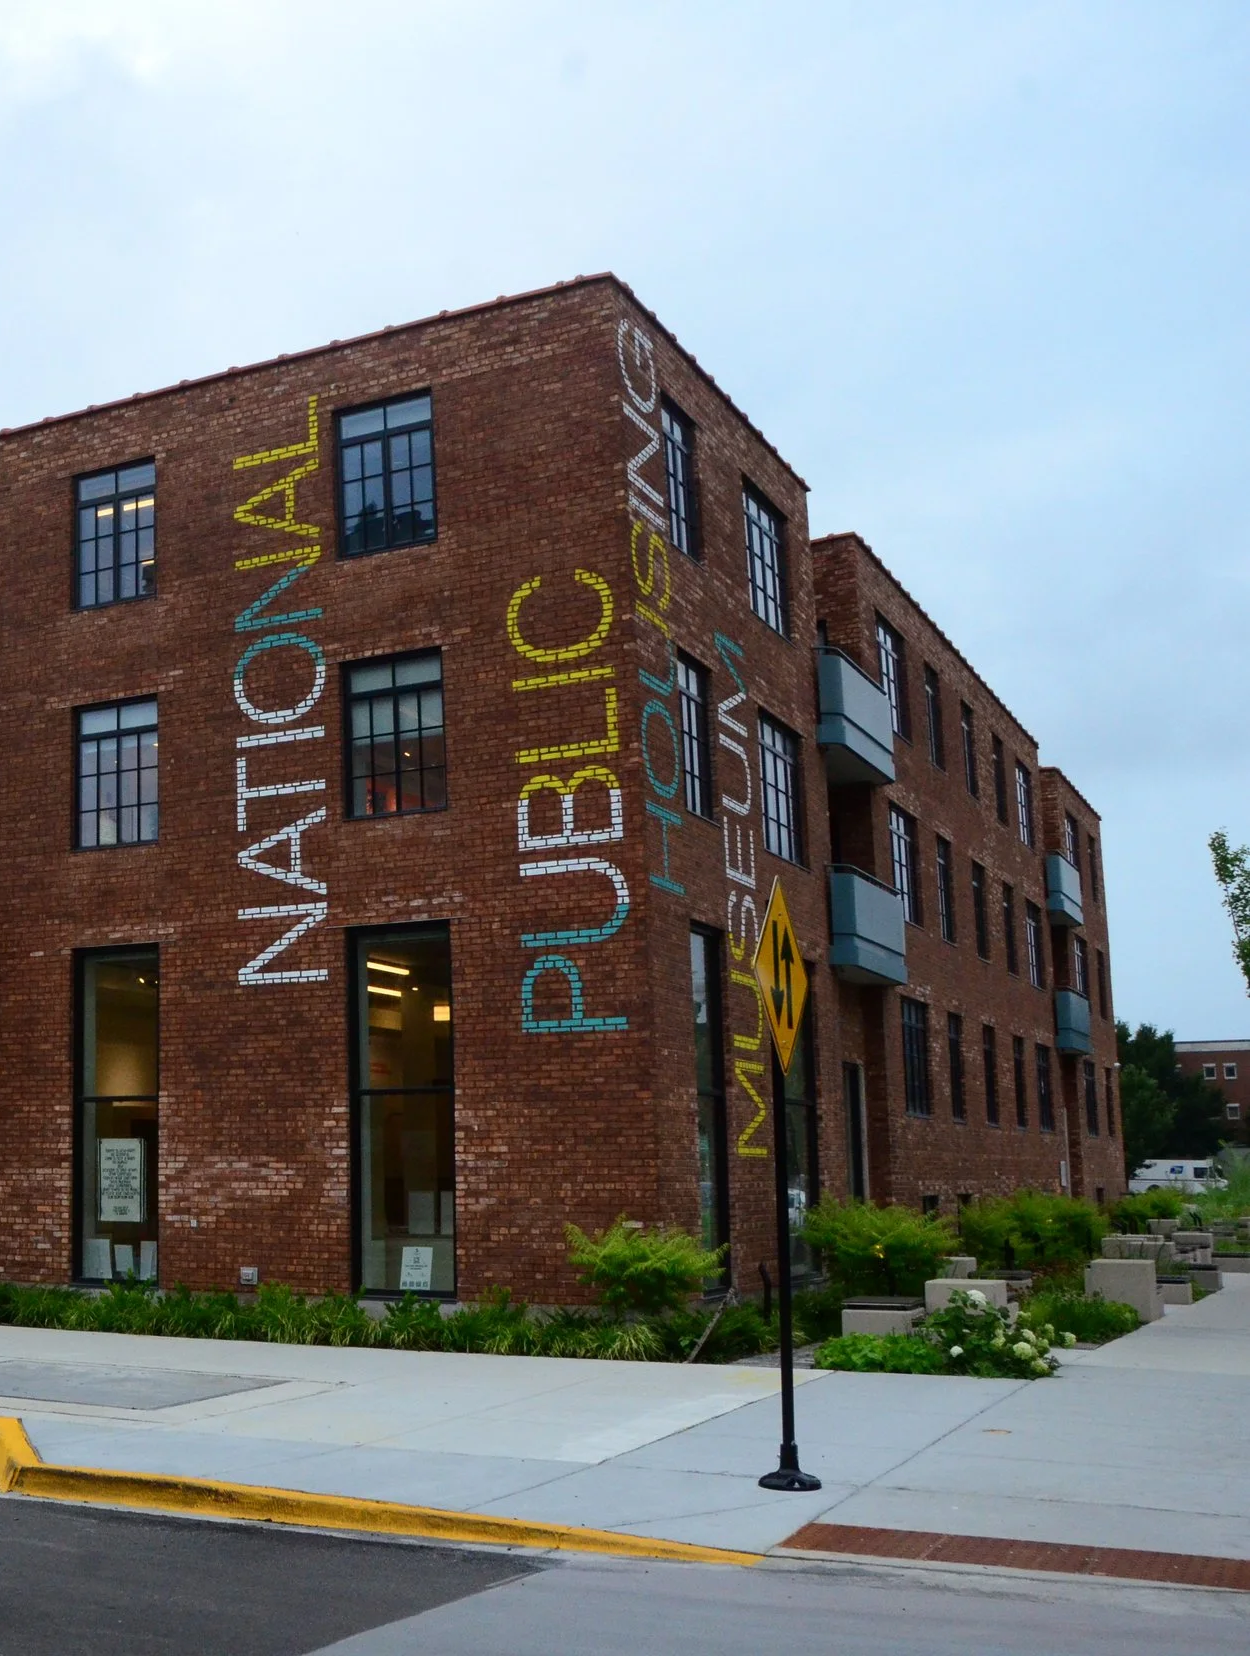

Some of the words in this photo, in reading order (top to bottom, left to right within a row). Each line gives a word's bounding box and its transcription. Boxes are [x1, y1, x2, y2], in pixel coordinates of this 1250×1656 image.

[232, 395, 328, 986] NATIONAL
[506, 568, 630, 1033] PUBLIC
[617, 318, 686, 896] HOUSING
[713, 628, 768, 1158] MUSEUM
